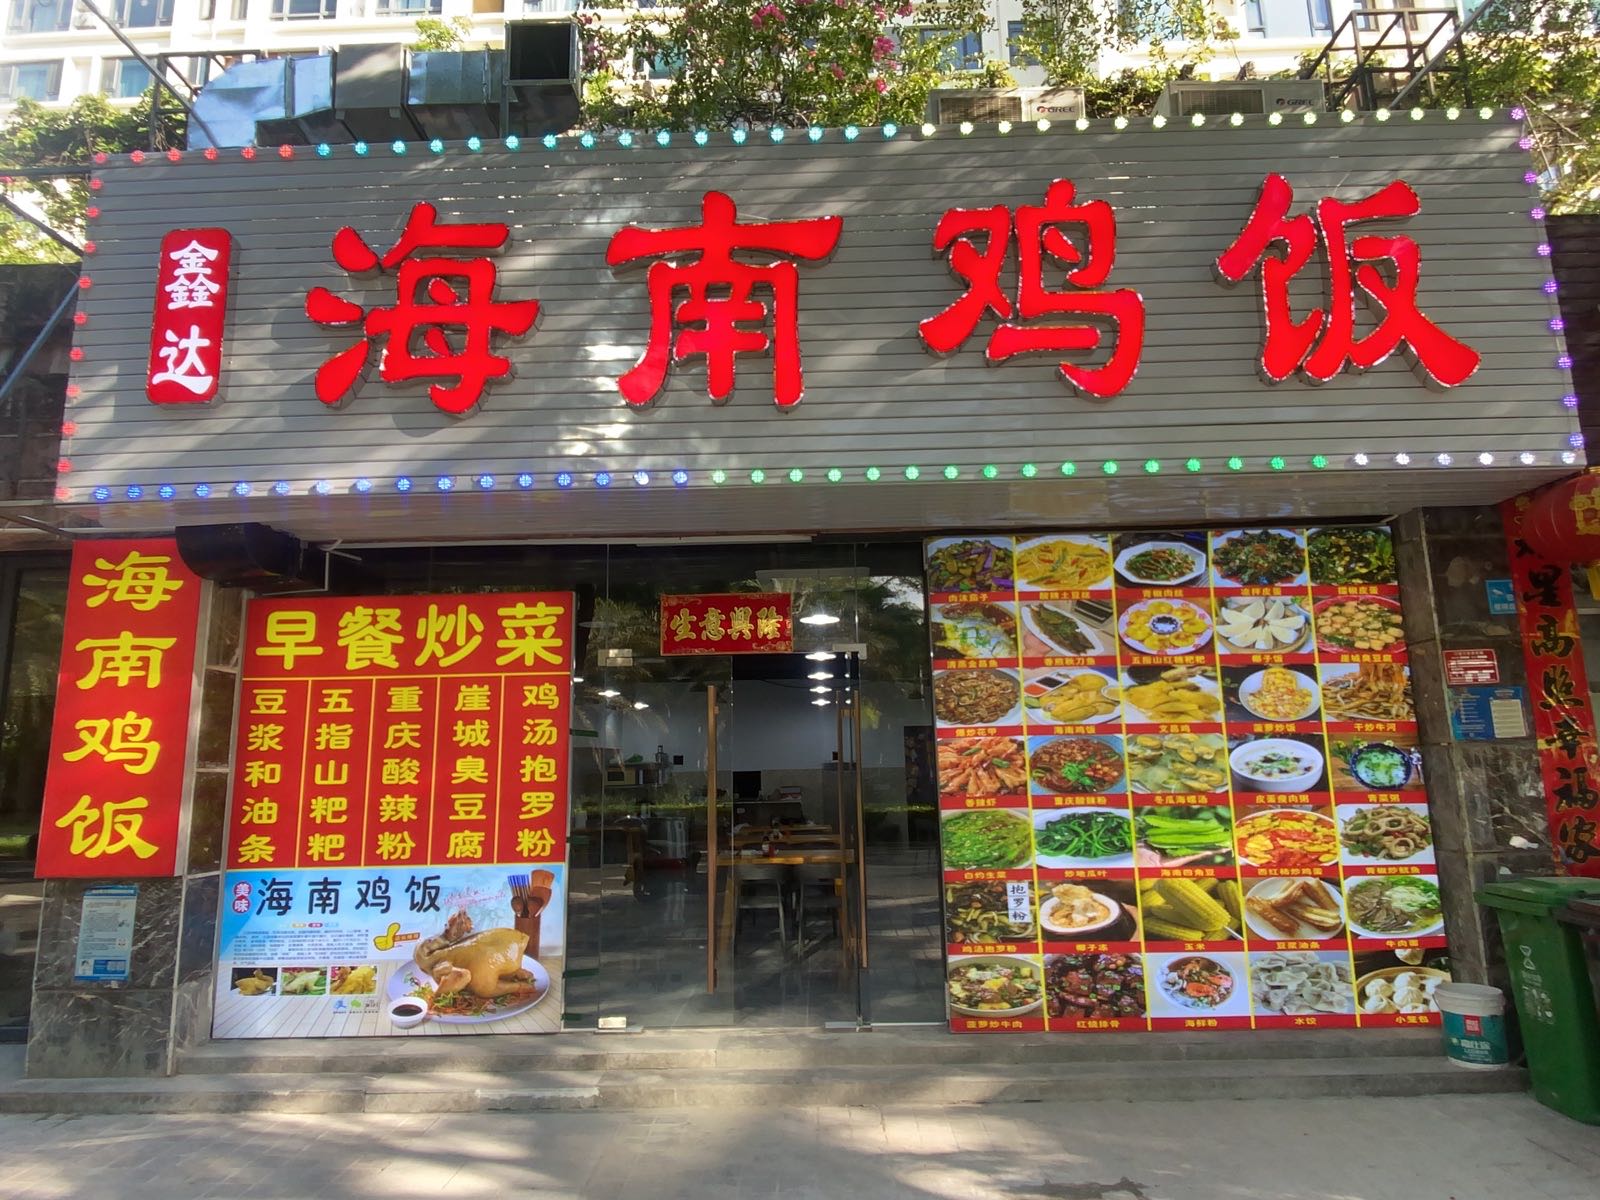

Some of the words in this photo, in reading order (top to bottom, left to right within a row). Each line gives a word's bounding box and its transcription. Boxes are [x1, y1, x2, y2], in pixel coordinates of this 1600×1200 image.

[304, 172, 1481, 414] 海南鸡饭
[152, 240, 220, 394] 鑫达
[1039, 592, 1090, 600] 酸辣土豆丝
[255, 602, 565, 670] 早餐炒菜
[1341, 654, 1392, 662] 崖城臭豆腐
[55, 551, 184, 859] 海南鸡饭
[1159, 725, 1190, 733] 文昌鸡
[1354, 723, 1396, 731] 干炒牛河
[376, 686, 423, 860] 重庆酸辣粉
[446, 684, 491, 859] 崖城臭豆腐
[516, 683, 559, 857] 鸡汤抱罗粉
[238, 689, 287, 863] 豆浆和油条
[306, 689, 354, 862] 五指山粑粑
[1054, 796, 1106, 805] 重庆酸辣粉
[1256, 794, 1309, 804] 皮蛋瘦肉粥
[1064, 870, 1107, 878] 炒地瓜叶
[1257, 868, 1322, 876] 西红柿炒鸡蛋
[234, 883, 250, 912] 美味
[256, 875, 440, 915] 海南鸡饭
[1185, 943, 1206, 951] 玉米
[1276, 942, 1320, 950] 豆浆油条
[1076, 1020, 1120, 1028] 红烧排骨
[1295, 1017, 1317, 1025] 水饺
